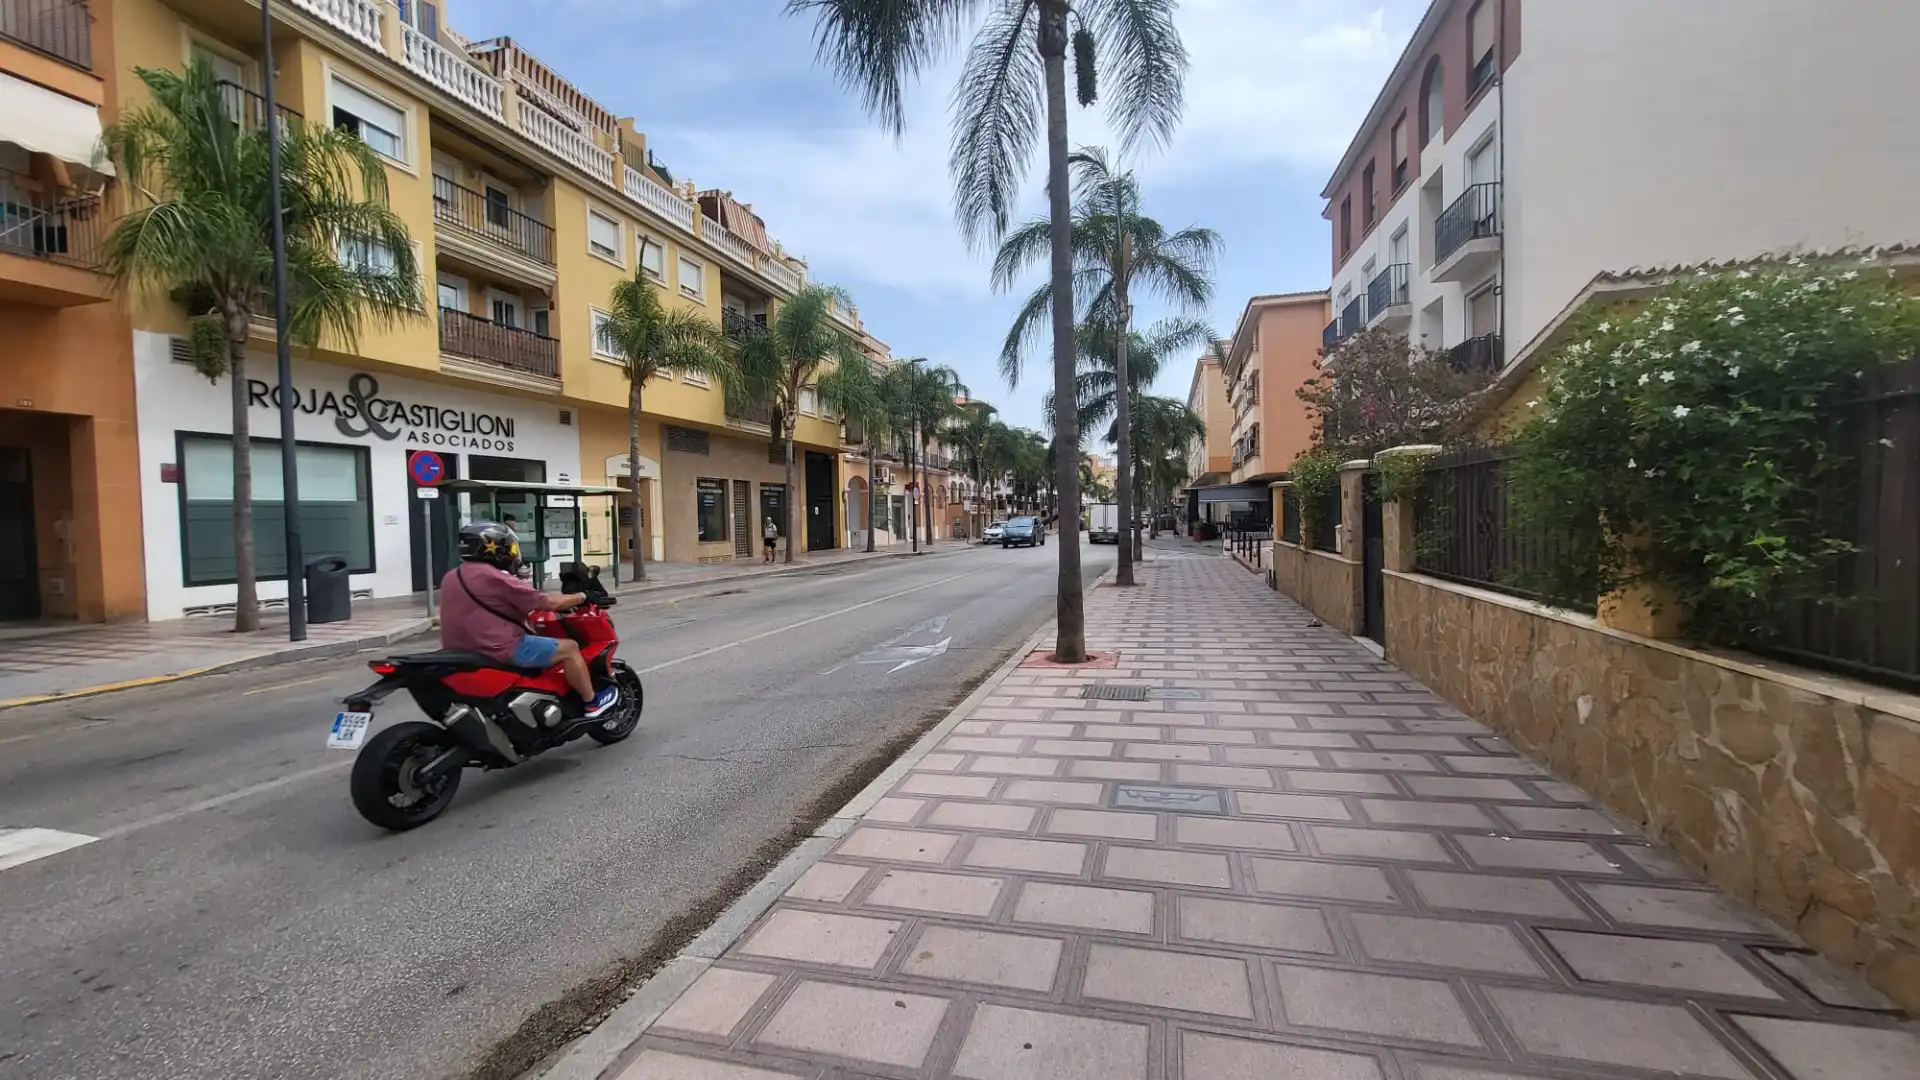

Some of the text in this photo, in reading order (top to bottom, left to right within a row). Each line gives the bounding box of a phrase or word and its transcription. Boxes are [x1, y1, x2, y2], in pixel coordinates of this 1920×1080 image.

[247, 373, 515, 441] ROJAS & CASTIGLIONI
[407, 431, 515, 452] ASOCIADOS
